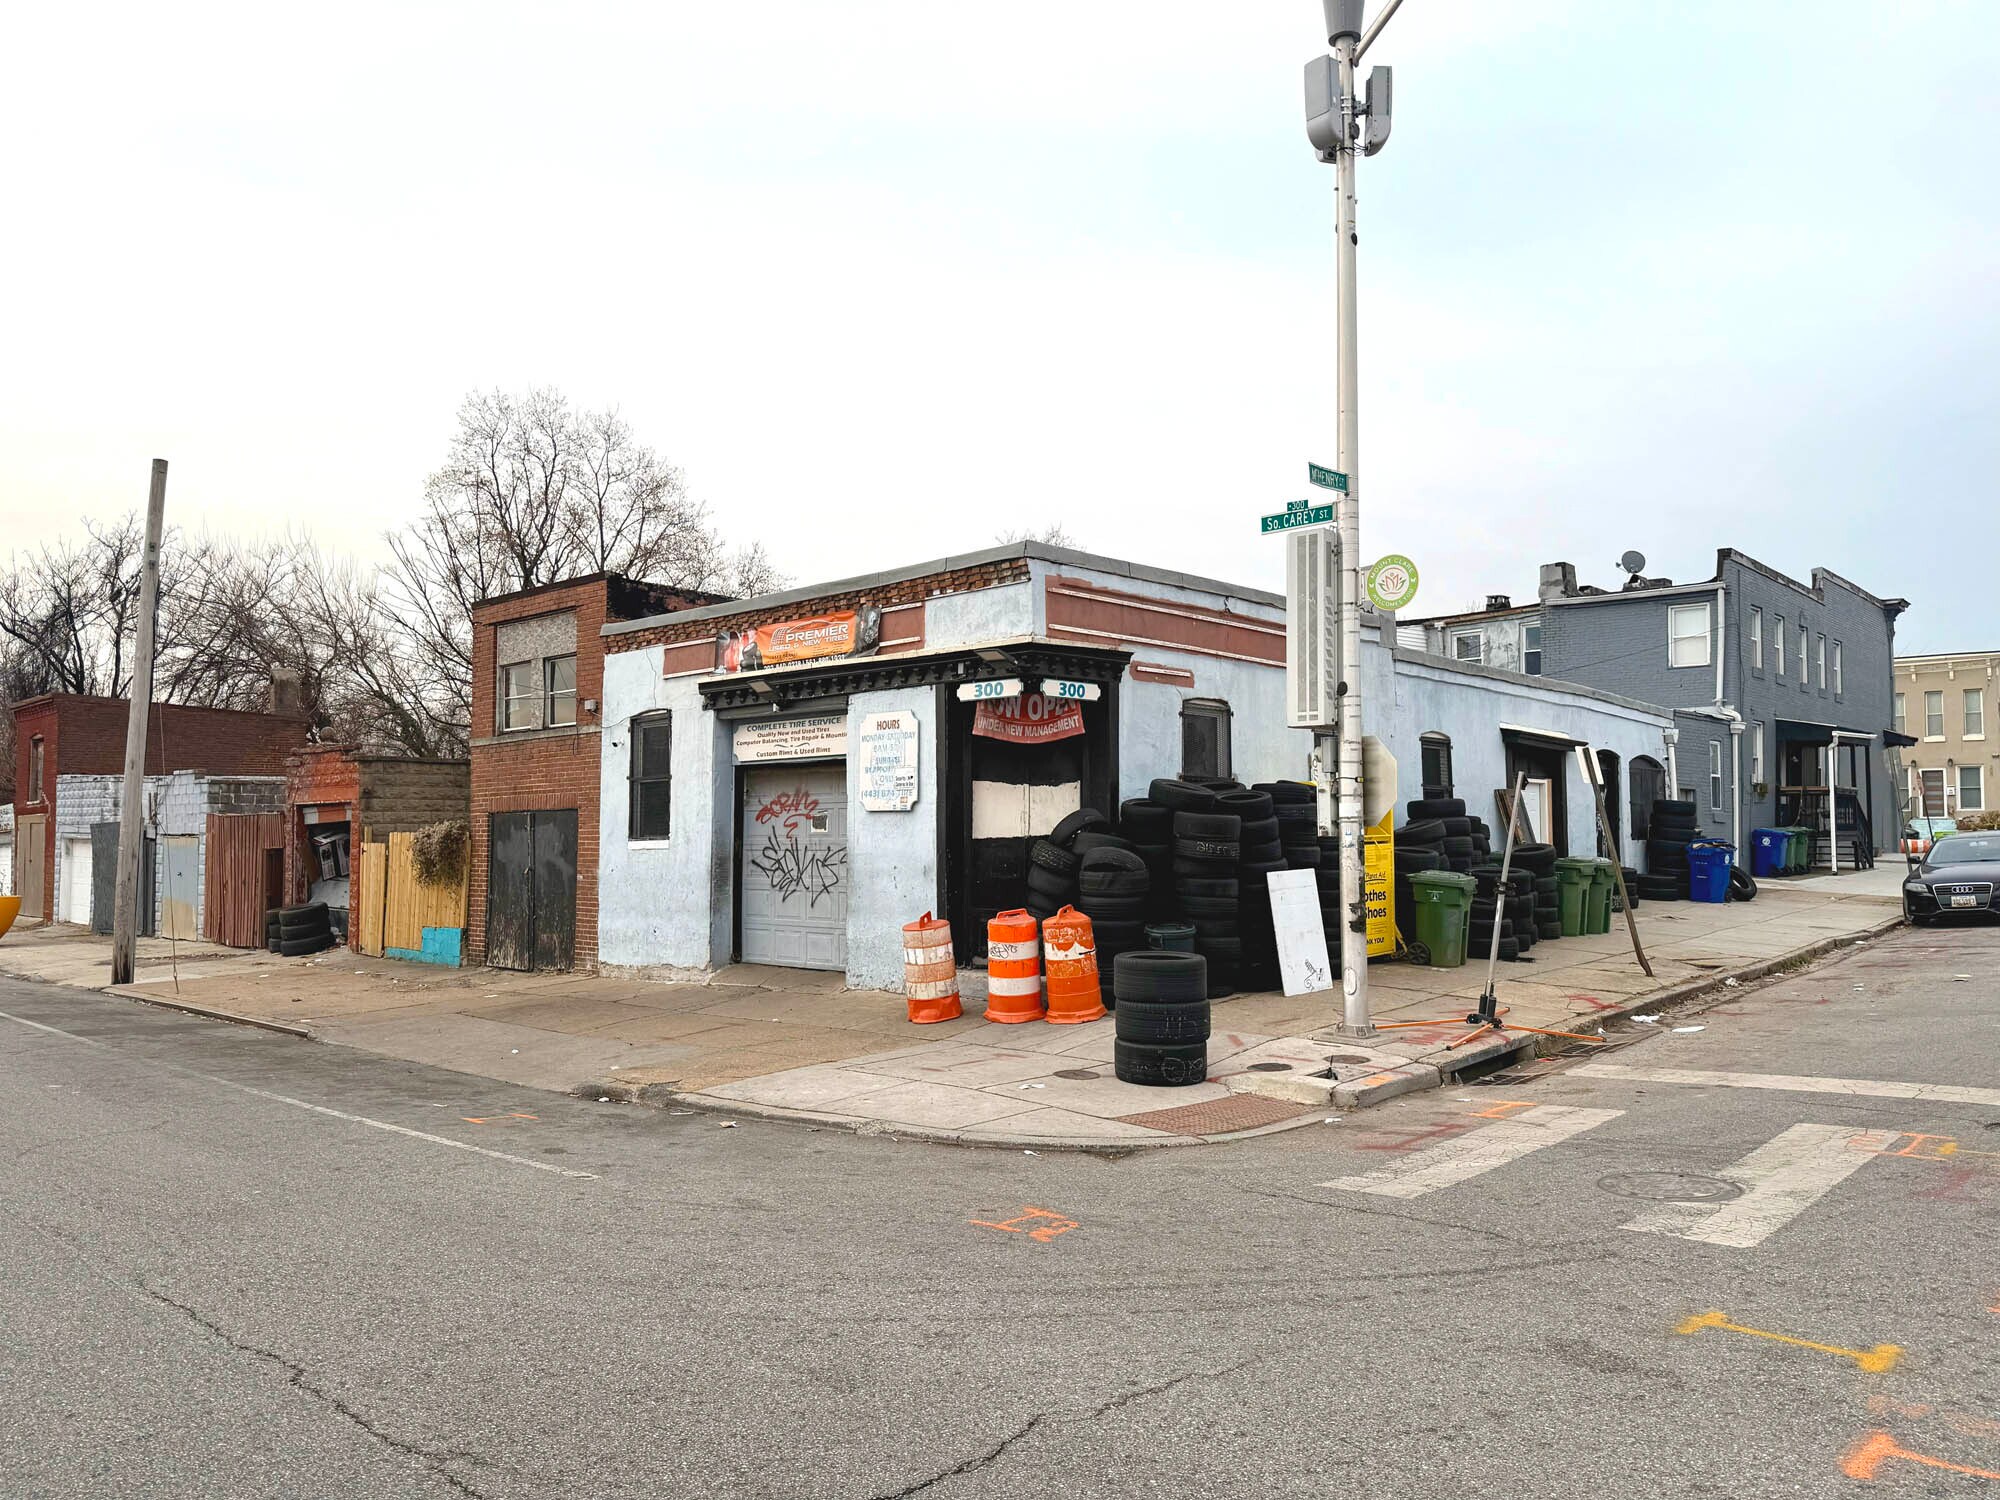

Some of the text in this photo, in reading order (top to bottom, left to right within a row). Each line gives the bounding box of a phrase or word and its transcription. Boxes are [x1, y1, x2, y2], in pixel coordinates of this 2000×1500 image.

[1292, 501, 1305, 510] 300
[1283, 510, 1316, 527] CAREY
[1370, 558, 1391, 578] MOUNT
[785, 624, 849, 643] PREMIER
[768, 643, 791, 652] USED
[803, 639, 821, 647] NEW
[825, 634, 849, 643] TIRES
[974, 682, 1004, 698] 300
[1058, 682, 1086, 698] 300
[746, 717, 842, 732] COMPLETE TIRE SERVICE
[876, 719, 900, 731] HOURS
[977, 715, 1080, 737] UNDER NEW MANAGEMENT
[757, 731, 776, 739] Quality
[756, 750, 778, 758] Custom
[1364, 889, 1387, 902] othes
